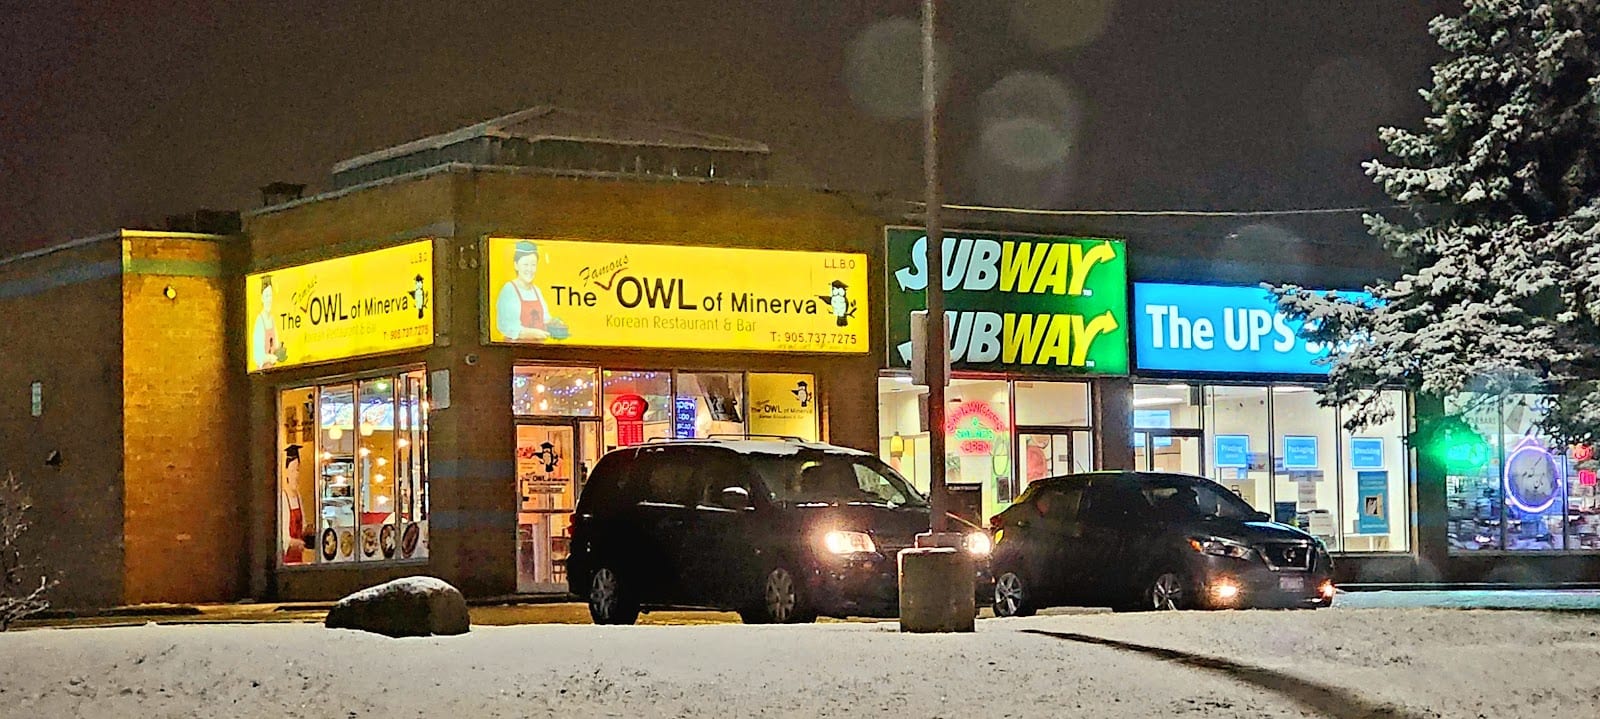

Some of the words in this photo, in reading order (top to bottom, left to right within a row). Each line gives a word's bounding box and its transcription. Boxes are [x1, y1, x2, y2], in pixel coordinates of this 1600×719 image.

[579, 254, 629, 287] Famous
[895, 236, 1116, 296] SUBWAY
[280, 313, 301, 330] The
[310, 292, 348, 325] OWL
[350, 300, 361, 319] of
[364, 295, 408, 317] Minerva
[551, 286, 597, 307] The
[616, 276, 697, 310] OWL
[702, 292, 722, 312] of
[731, 293, 817, 314] Minerva
[606, 315, 649, 329] Korean
[653, 316, 719, 331] Restaurant
[723, 319, 732, 332] &
[736, 318, 757, 332] Bar
[769, 331, 781, 342] T:
[784, 332, 857, 345] 905.737.7275
[897, 311, 1118, 366] UBWAY
[1145, 304, 1215, 350] The
[1223, 307, 1296, 353] UPS
[764, 404, 782, 413] OWL
